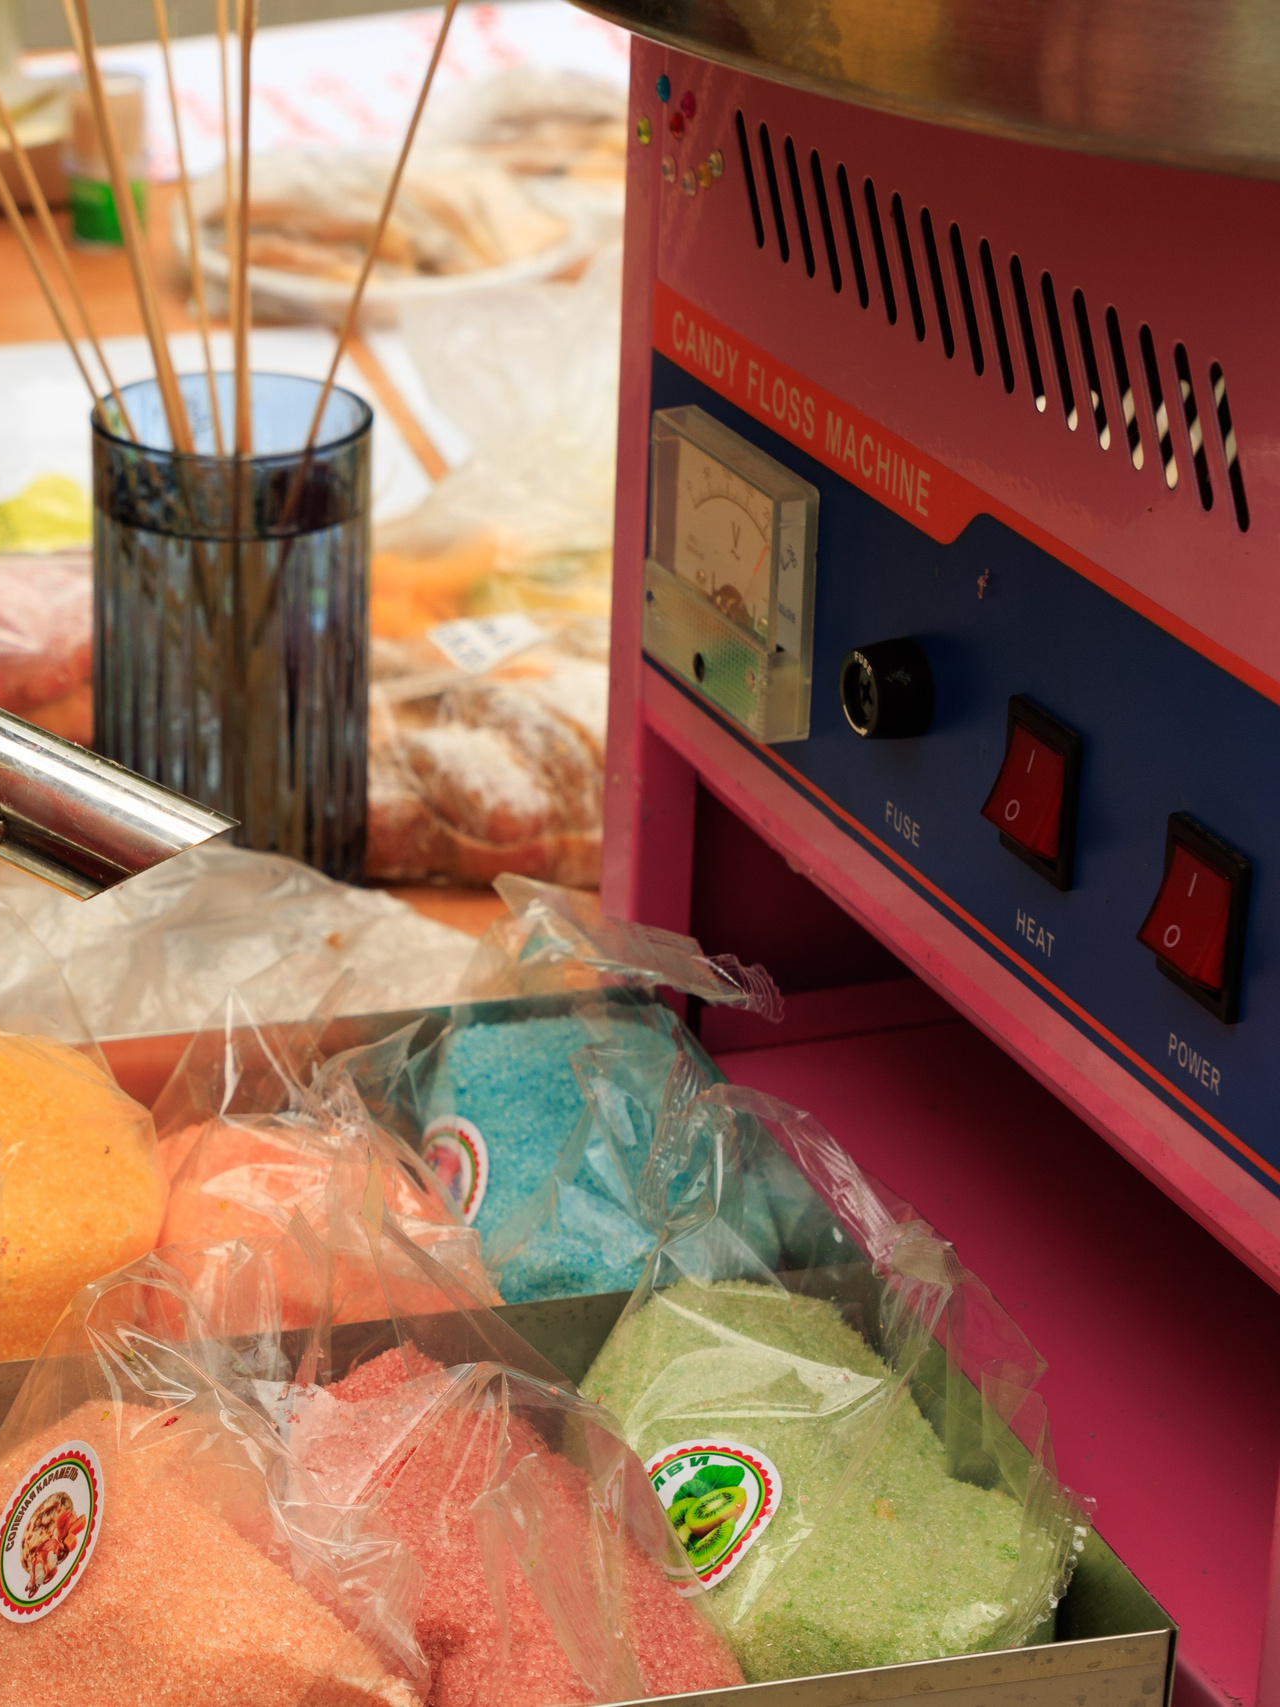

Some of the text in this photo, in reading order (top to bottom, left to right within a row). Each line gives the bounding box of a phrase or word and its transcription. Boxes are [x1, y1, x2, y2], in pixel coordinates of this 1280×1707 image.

[672, 311, 739, 387] CANDY
[747, 359, 816, 440] FLOSS
[825, 410, 931, 518] MACHINE
[854, 650, 873, 676] FUSE
[885, 801, 920, 848] FUSE
[1016, 908, 1055, 958] HEAT
[1168, 1032, 1221, 1097] POWER
[4, 1466, 79, 1552] СОЛЕНАЯ КАРАМЕЛЬ
